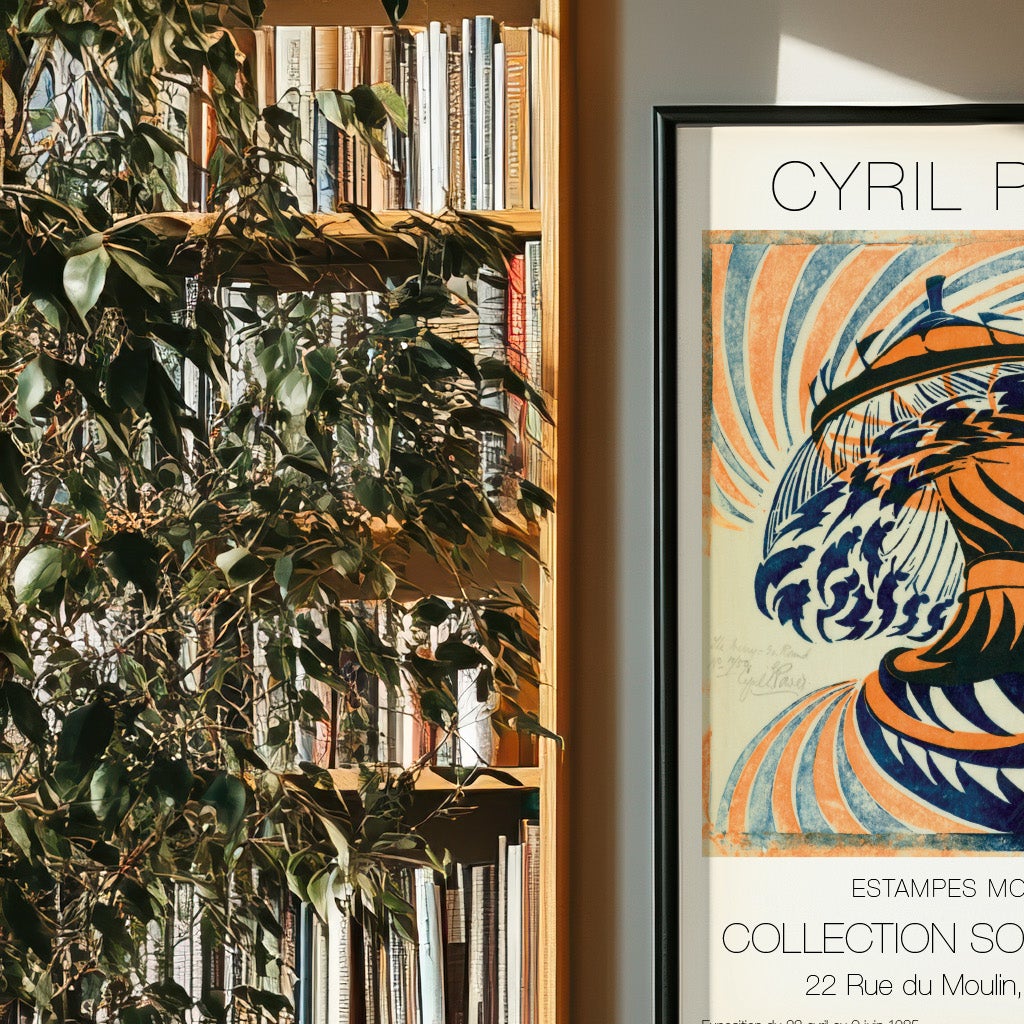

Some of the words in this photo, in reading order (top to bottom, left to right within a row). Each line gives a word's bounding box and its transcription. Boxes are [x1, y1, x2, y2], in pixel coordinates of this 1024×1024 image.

[772, 160, 962, 211] CYRIL
[852, 878, 976, 898] ESTAMPES
[722, 922, 956, 954] COLLECTION
[805, 974, 836, 996] 22
[846, 974, 893, 996] Rue
[902, 974, 932, 996] du
[942, 974, 1021, 1000] Moulin,
